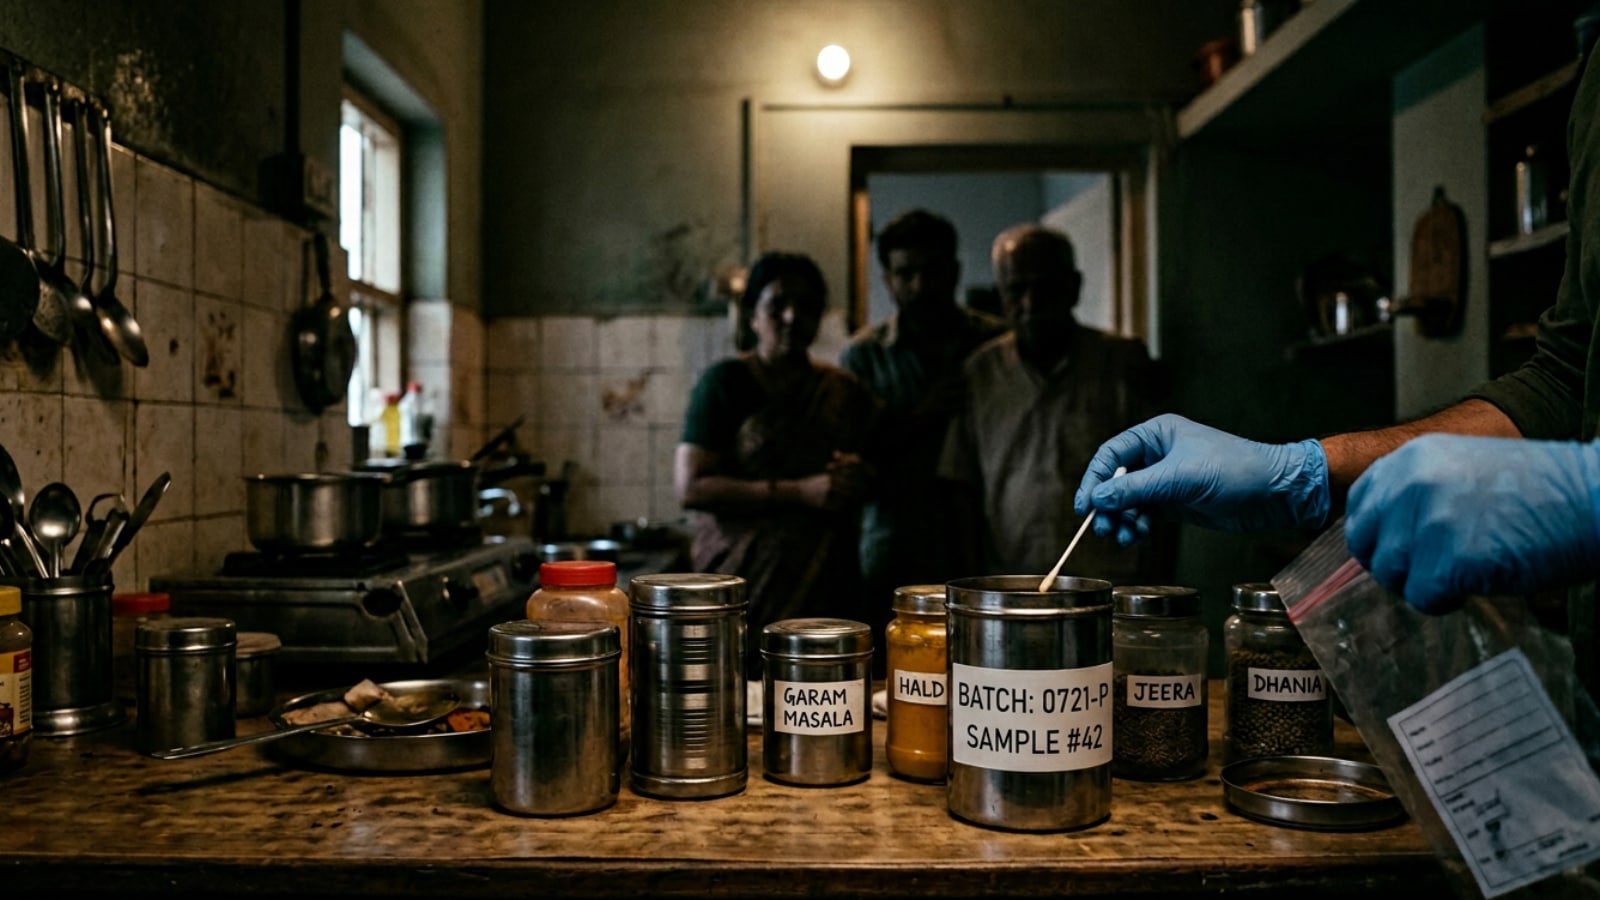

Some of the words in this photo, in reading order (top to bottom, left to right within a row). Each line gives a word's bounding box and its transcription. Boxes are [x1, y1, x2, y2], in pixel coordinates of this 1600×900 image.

[1133, 681, 1196, 701] JEERA
[1253, 674, 1322, 693] DHANIA
[783, 687, 847, 707] GARAM
[958, 681, 1034, 714] BATCH:
[1042, 681, 1109, 714] 0721-P
[783, 709, 854, 729] MASALA
[967, 724, 1060, 755] SAMPLE
[1067, 723, 1103, 753] #42
